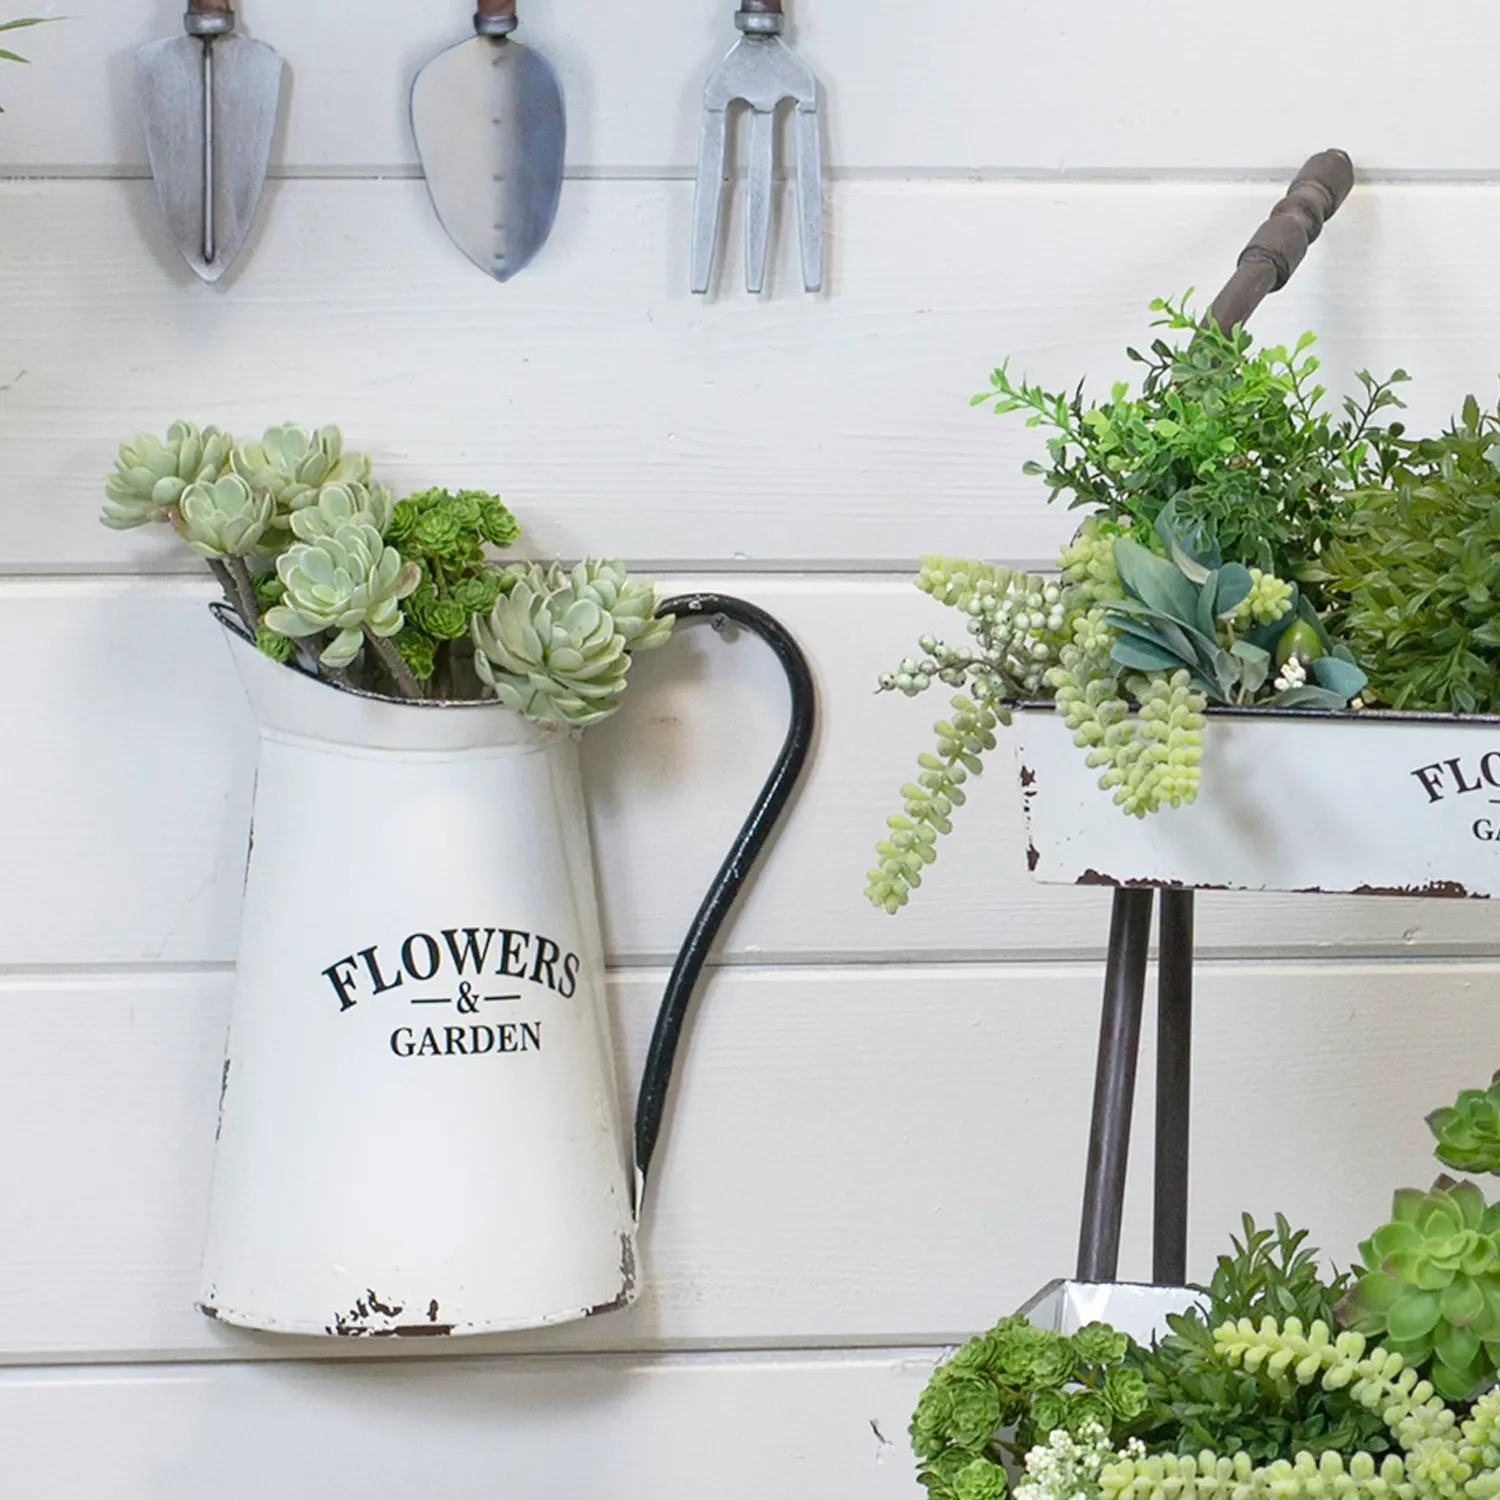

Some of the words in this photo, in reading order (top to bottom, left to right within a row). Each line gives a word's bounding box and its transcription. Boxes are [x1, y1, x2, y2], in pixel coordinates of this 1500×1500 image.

[321, 927, 581, 1013] FLOWERS
[456, 980, 480, 1015] &
[390, 1021, 542, 1057] GARDEN
